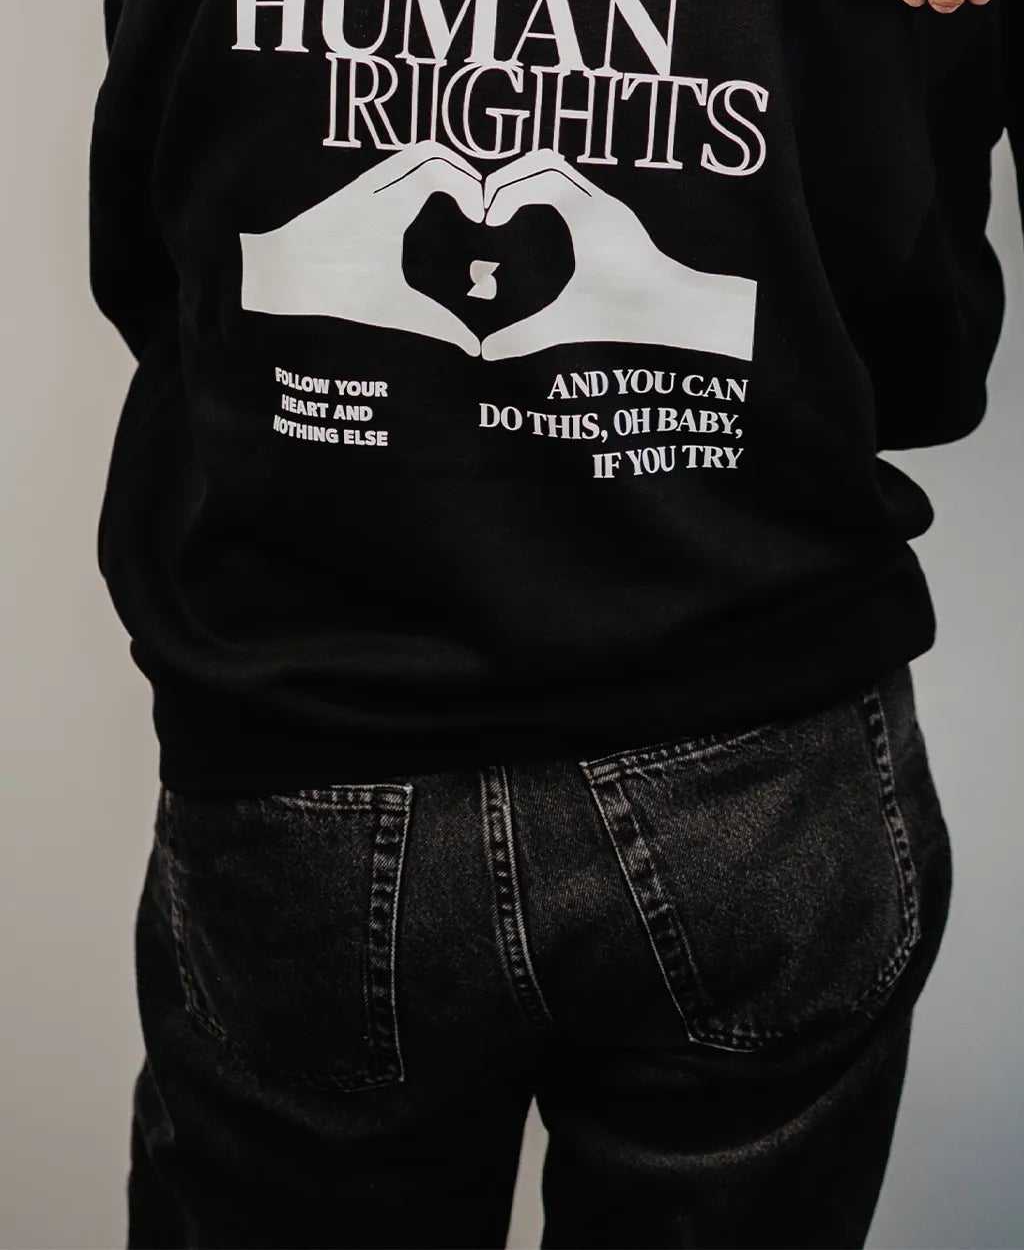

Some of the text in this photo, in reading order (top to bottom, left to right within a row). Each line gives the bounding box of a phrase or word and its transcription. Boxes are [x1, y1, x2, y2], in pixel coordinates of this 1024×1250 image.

[322, 52, 770, 177] RIGHTS
[274, 366, 389, 398] FOLLOW YOUR
[547, 369, 749, 403] AND YOU CAN
[281, 394, 373, 422] HEART AND
[478, 402, 743, 443] DO THIS, OH BABY,
[272, 414, 389, 447] NOTHING ELSE
[592, 444, 744, 479] IF YOU TRY
